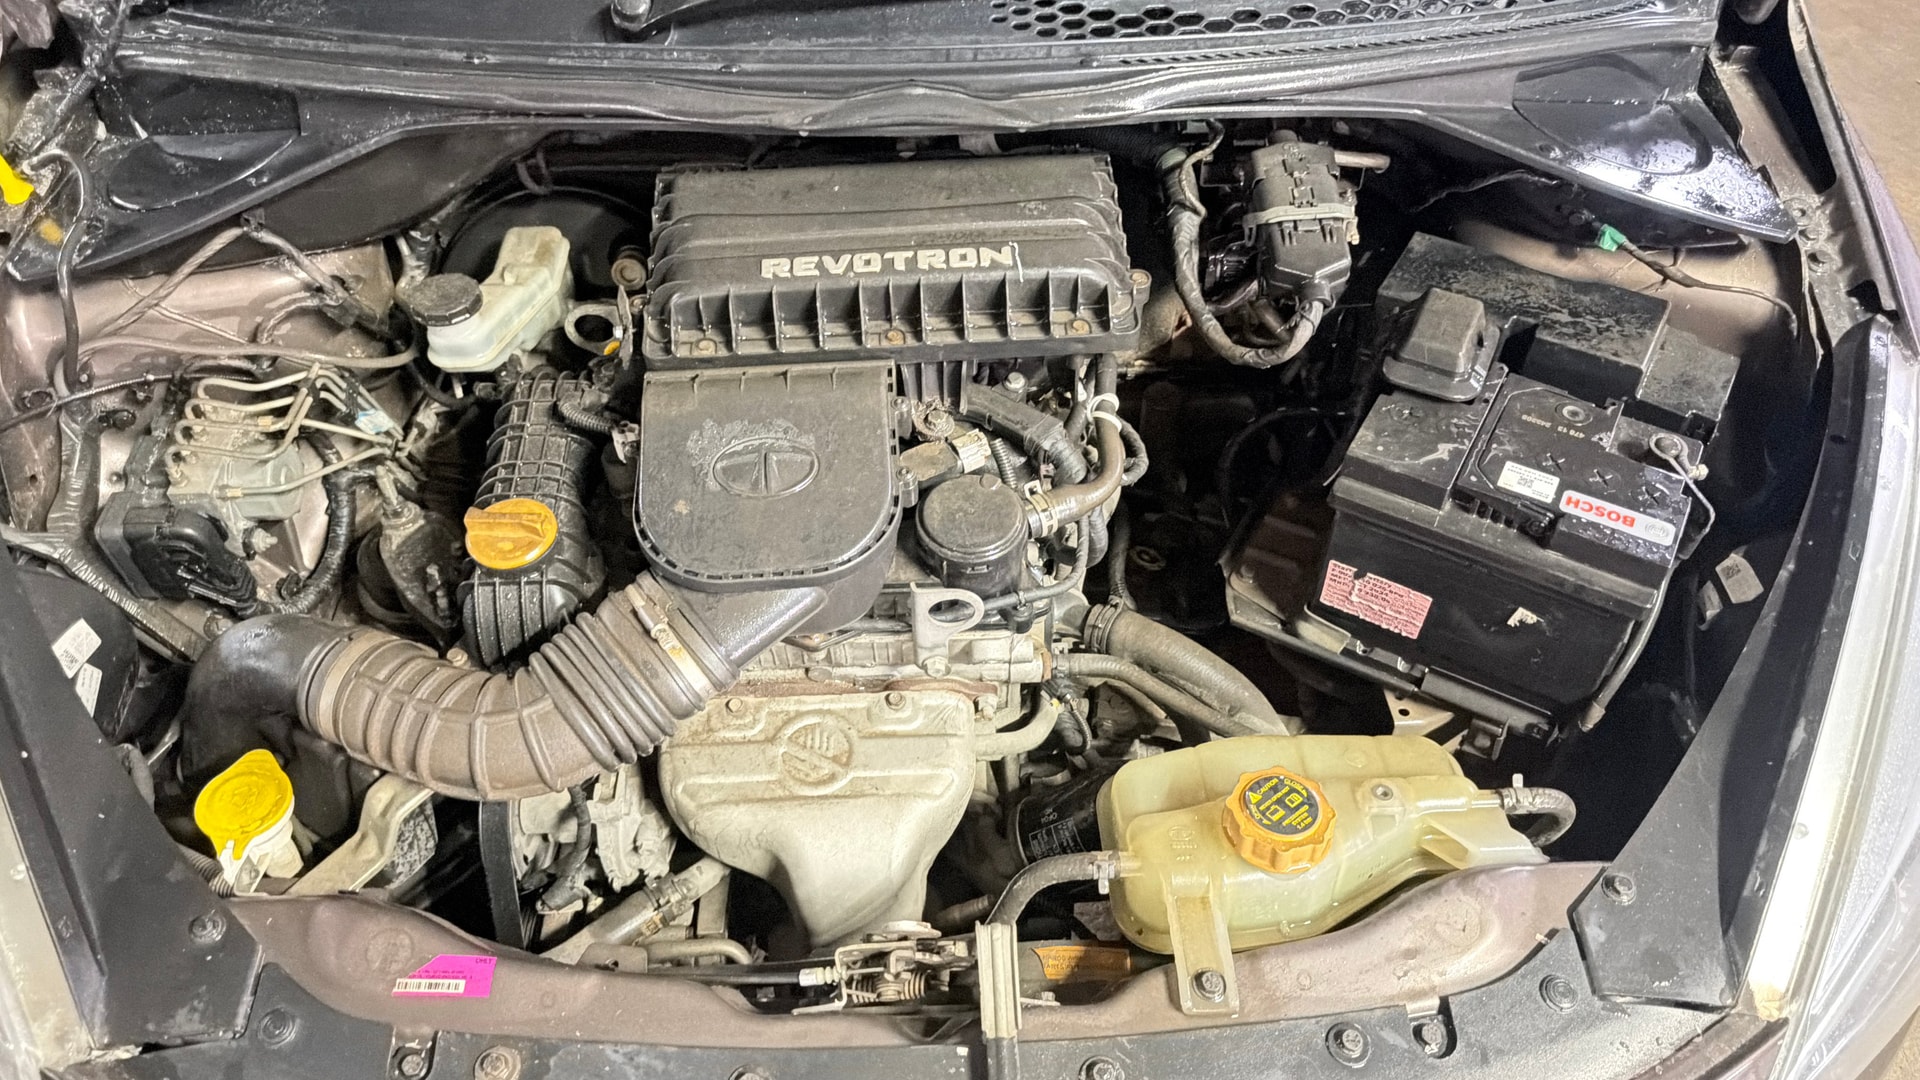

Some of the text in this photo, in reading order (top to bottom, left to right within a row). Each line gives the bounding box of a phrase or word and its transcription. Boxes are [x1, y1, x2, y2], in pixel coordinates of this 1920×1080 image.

[760, 245, 1013, 279] REVOTRON
[1564, 495, 1636, 528] BOSCH
[1257, 778, 1278, 794] CAUTION
